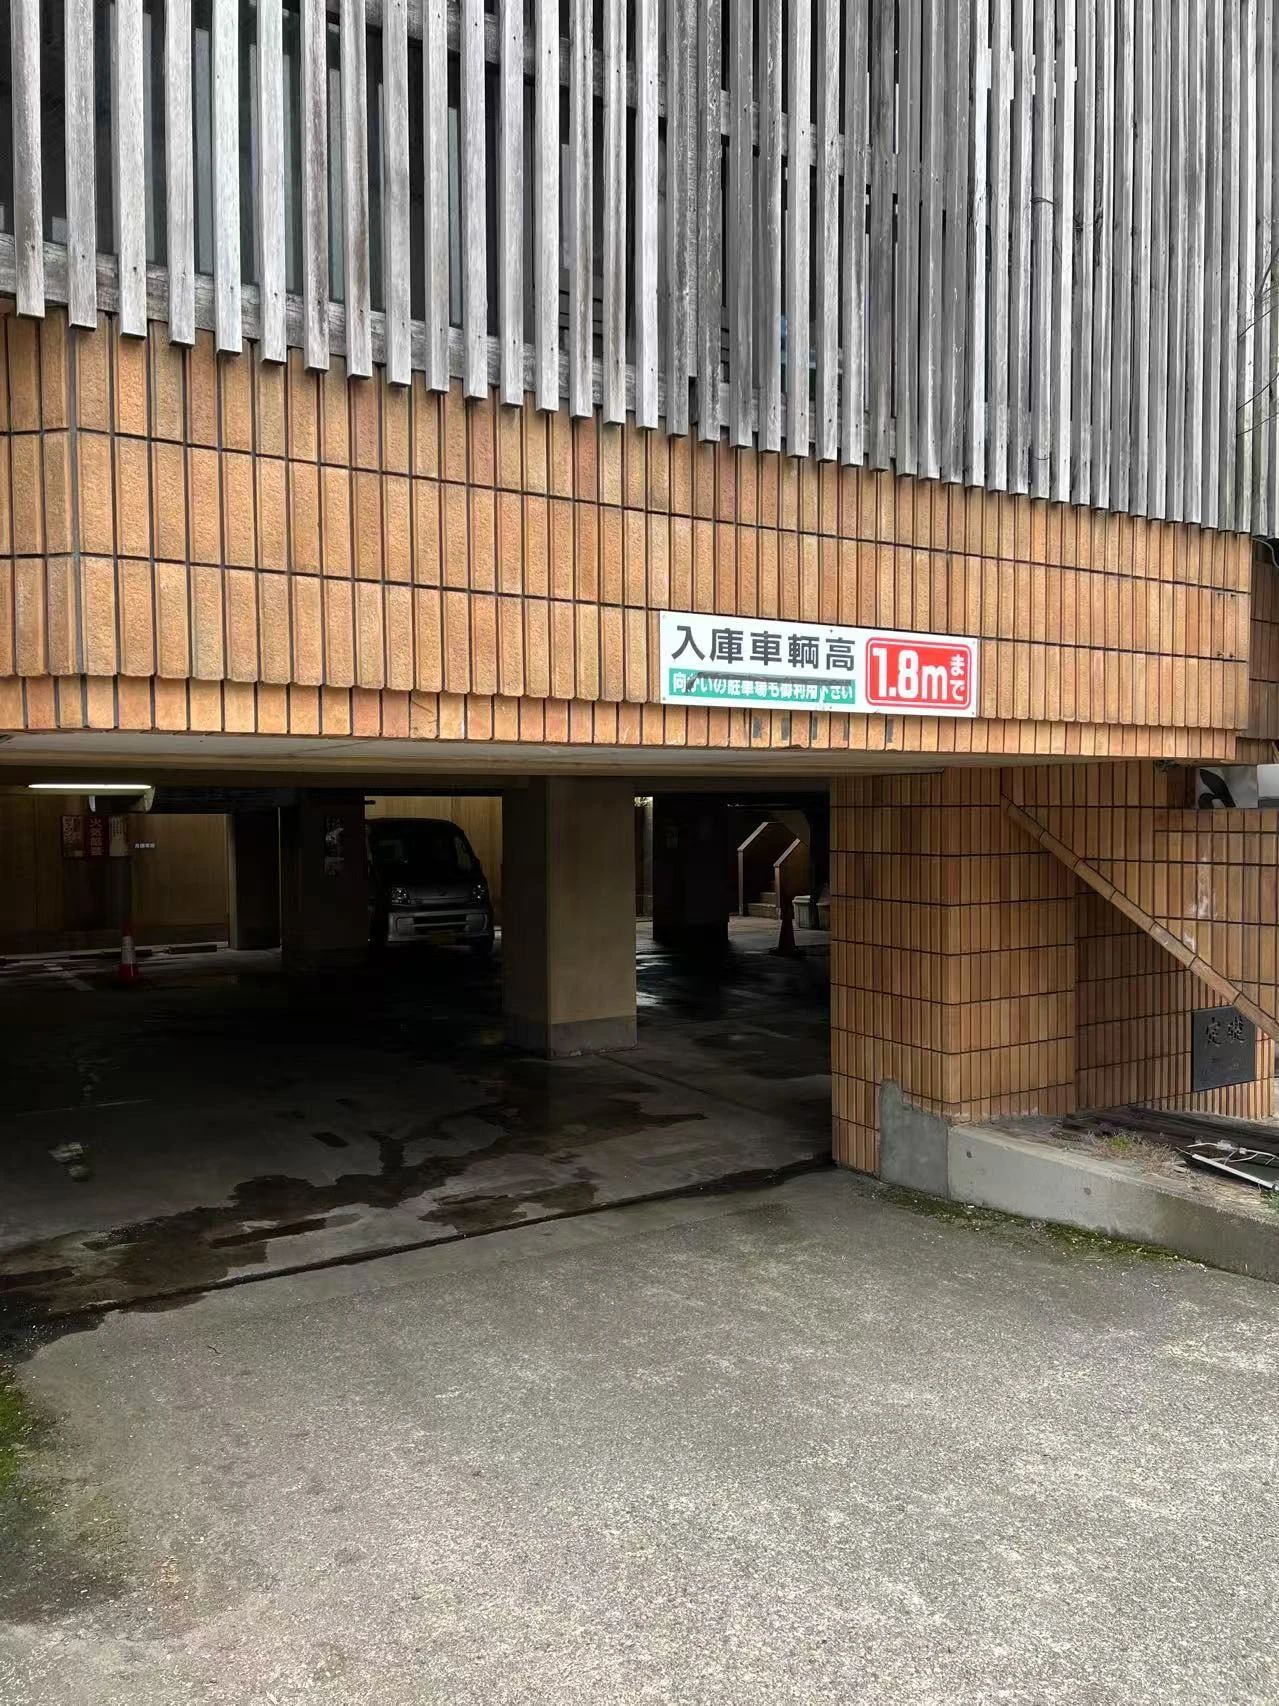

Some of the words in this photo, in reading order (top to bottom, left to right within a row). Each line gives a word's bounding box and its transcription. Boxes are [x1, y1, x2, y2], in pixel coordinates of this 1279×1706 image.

[671, 625, 855, 671] 入庫車輌高
[872, 647, 948, 700] 1.8m
[949, 653, 965, 702] まで
